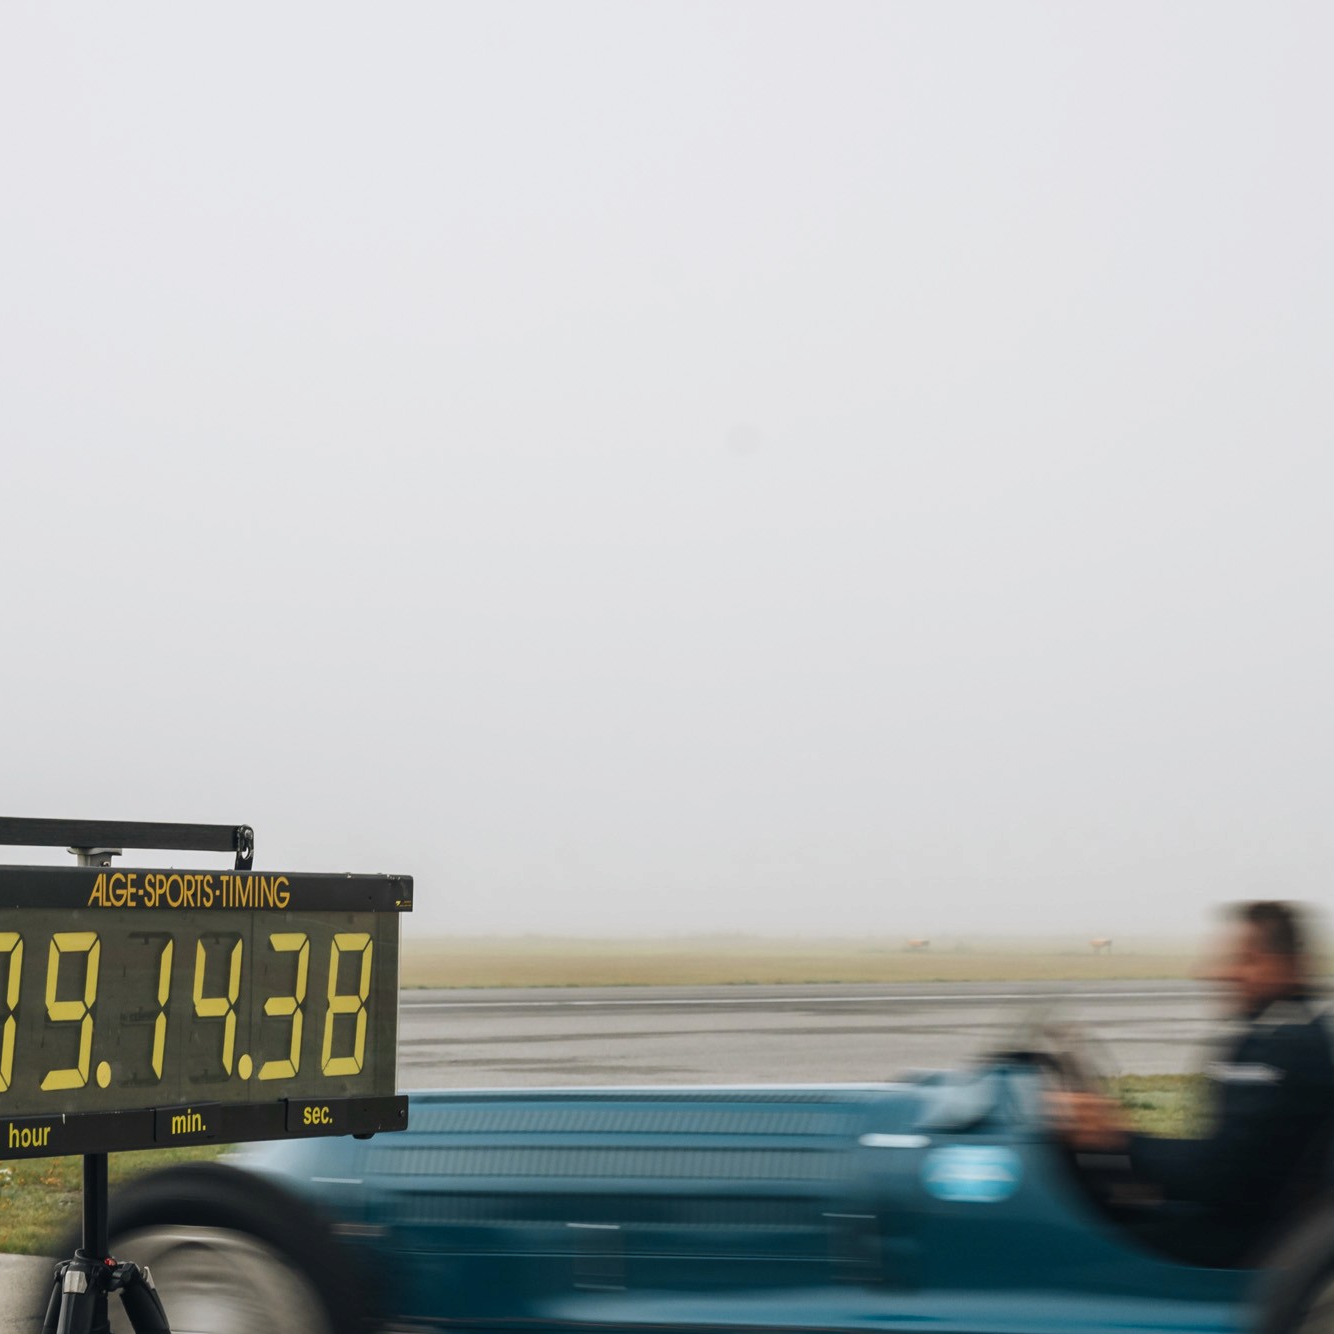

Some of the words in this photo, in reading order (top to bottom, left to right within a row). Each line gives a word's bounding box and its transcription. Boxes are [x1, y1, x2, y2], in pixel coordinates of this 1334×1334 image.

[88, 873, 290, 909] ALGE-SPORTS-TIMING
[8, 1123, 51, 1148] hour
[171, 1108, 206, 1134] min.
[303, 1104, 333, 1125] sec.
